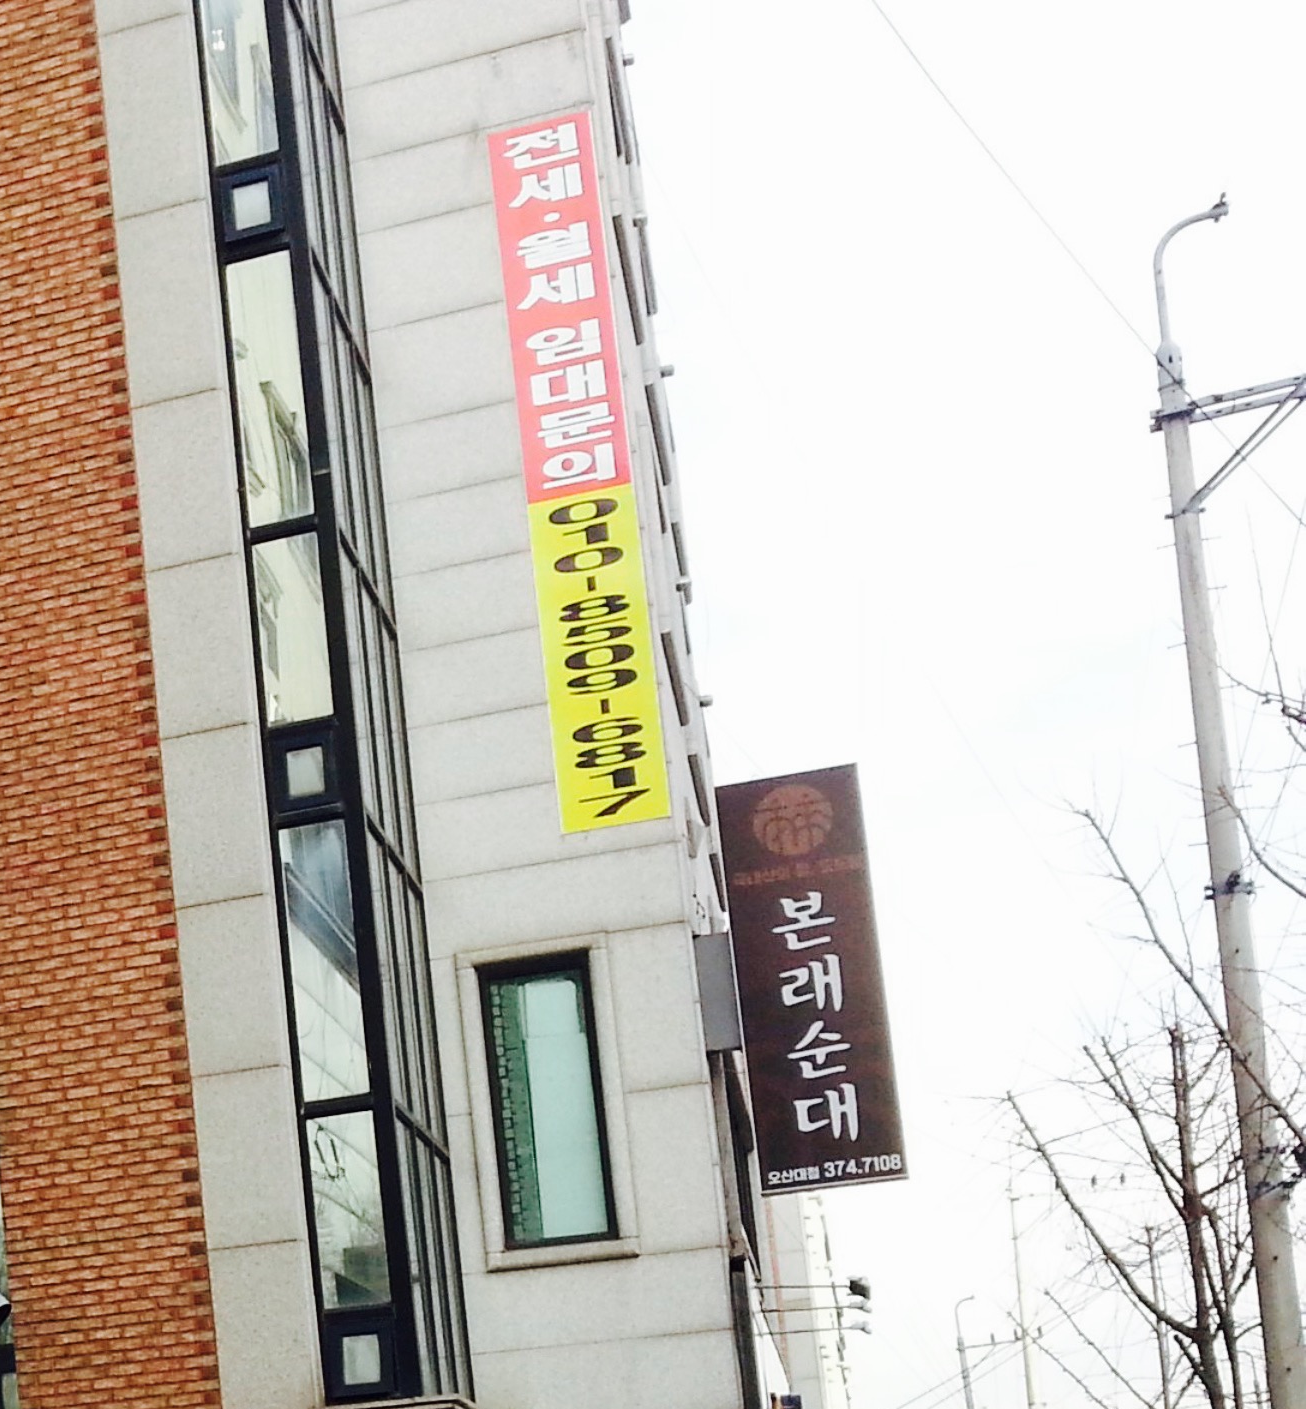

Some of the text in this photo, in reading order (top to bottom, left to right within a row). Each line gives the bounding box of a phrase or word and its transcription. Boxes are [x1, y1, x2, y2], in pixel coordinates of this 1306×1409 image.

[526, 317, 617, 489] 임대문의
[549, 498, 651, 818] 010-8509-6817
[772, 891, 861, 1142] 본래순대
[823, 1153, 902, 1178] 374.7108
